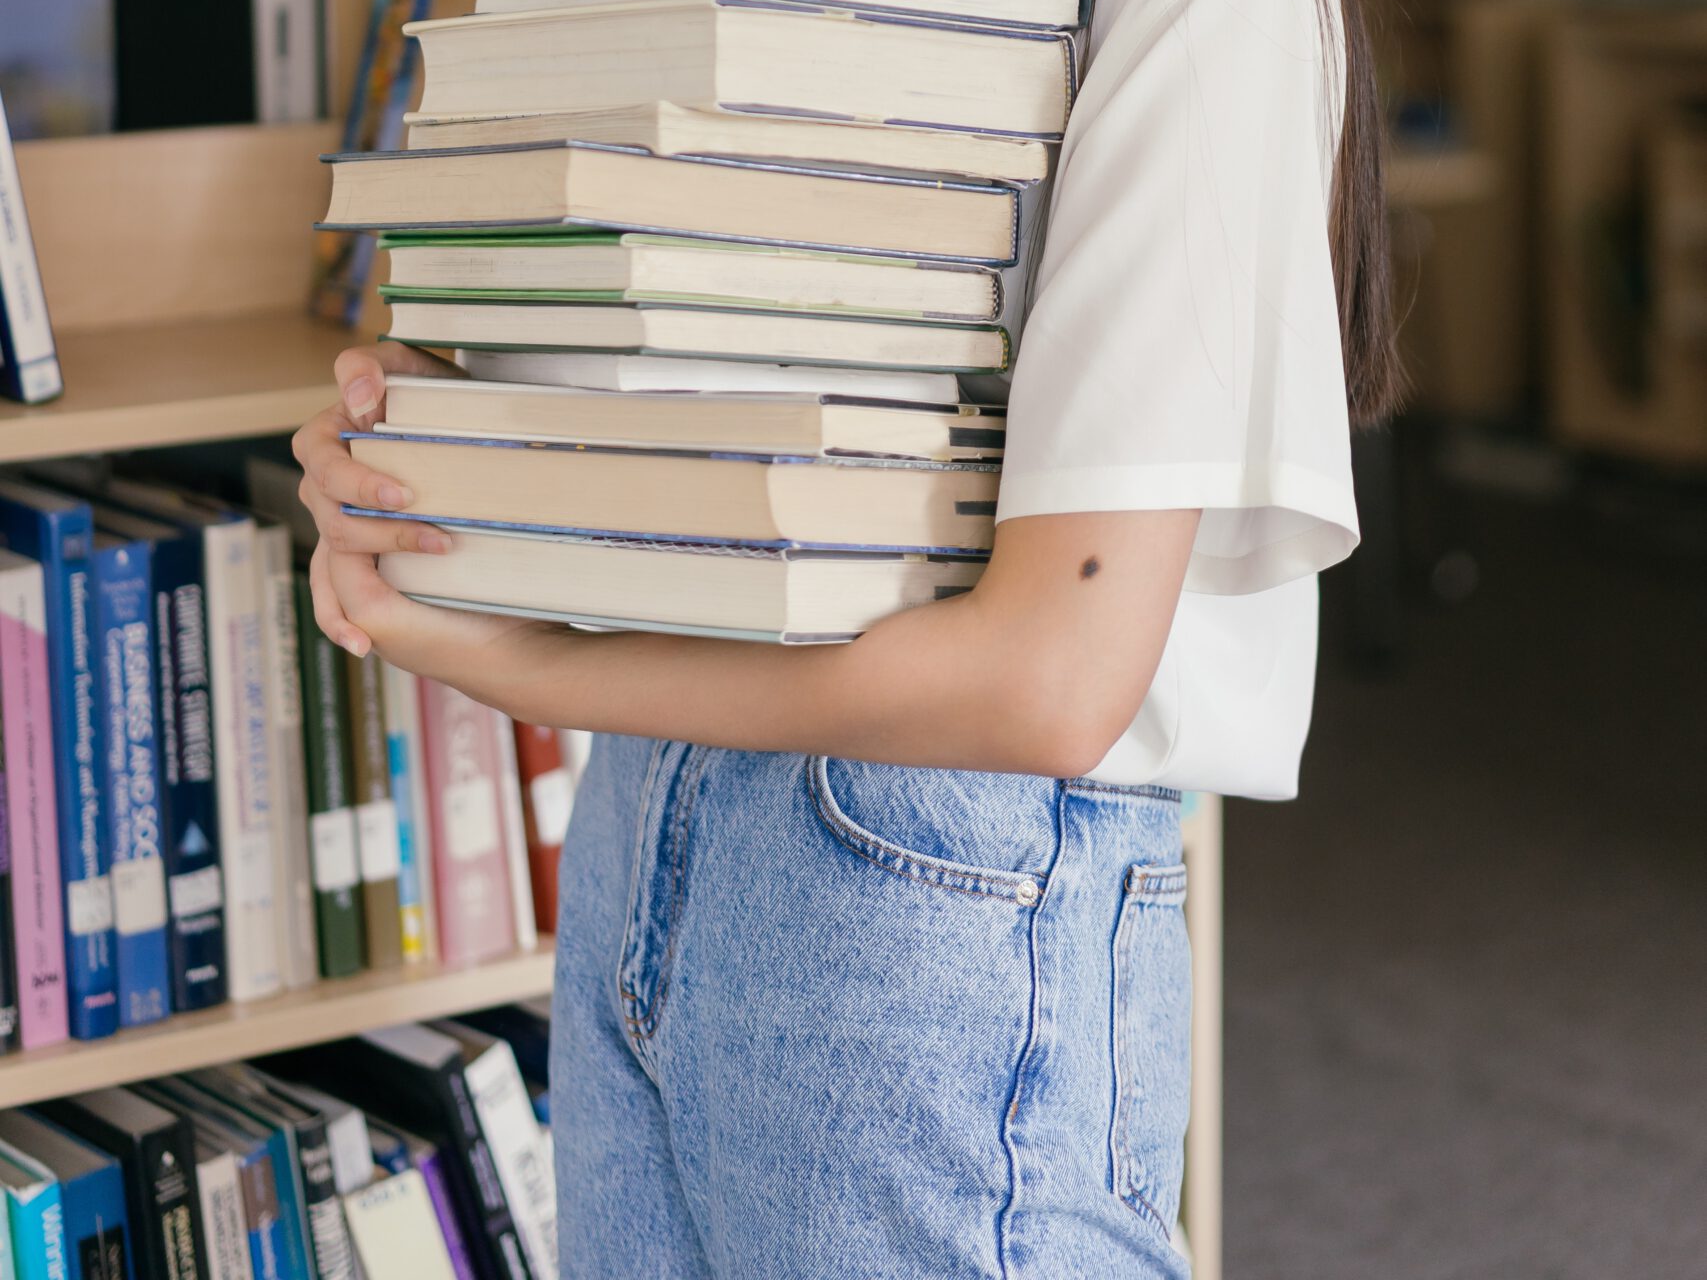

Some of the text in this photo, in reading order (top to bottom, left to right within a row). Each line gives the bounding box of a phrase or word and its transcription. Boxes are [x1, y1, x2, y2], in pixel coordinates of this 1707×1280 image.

[70, 572, 89, 669] Information
[105, 628, 124, 705] Corporate
[124, 622, 154, 740] BUSINESS
[173, 583, 213, 782] CORPORATE STRATEGY
[74, 674, 96, 763] Technology
[79, 766, 98, 797] and
[129, 743, 156, 802] AND
